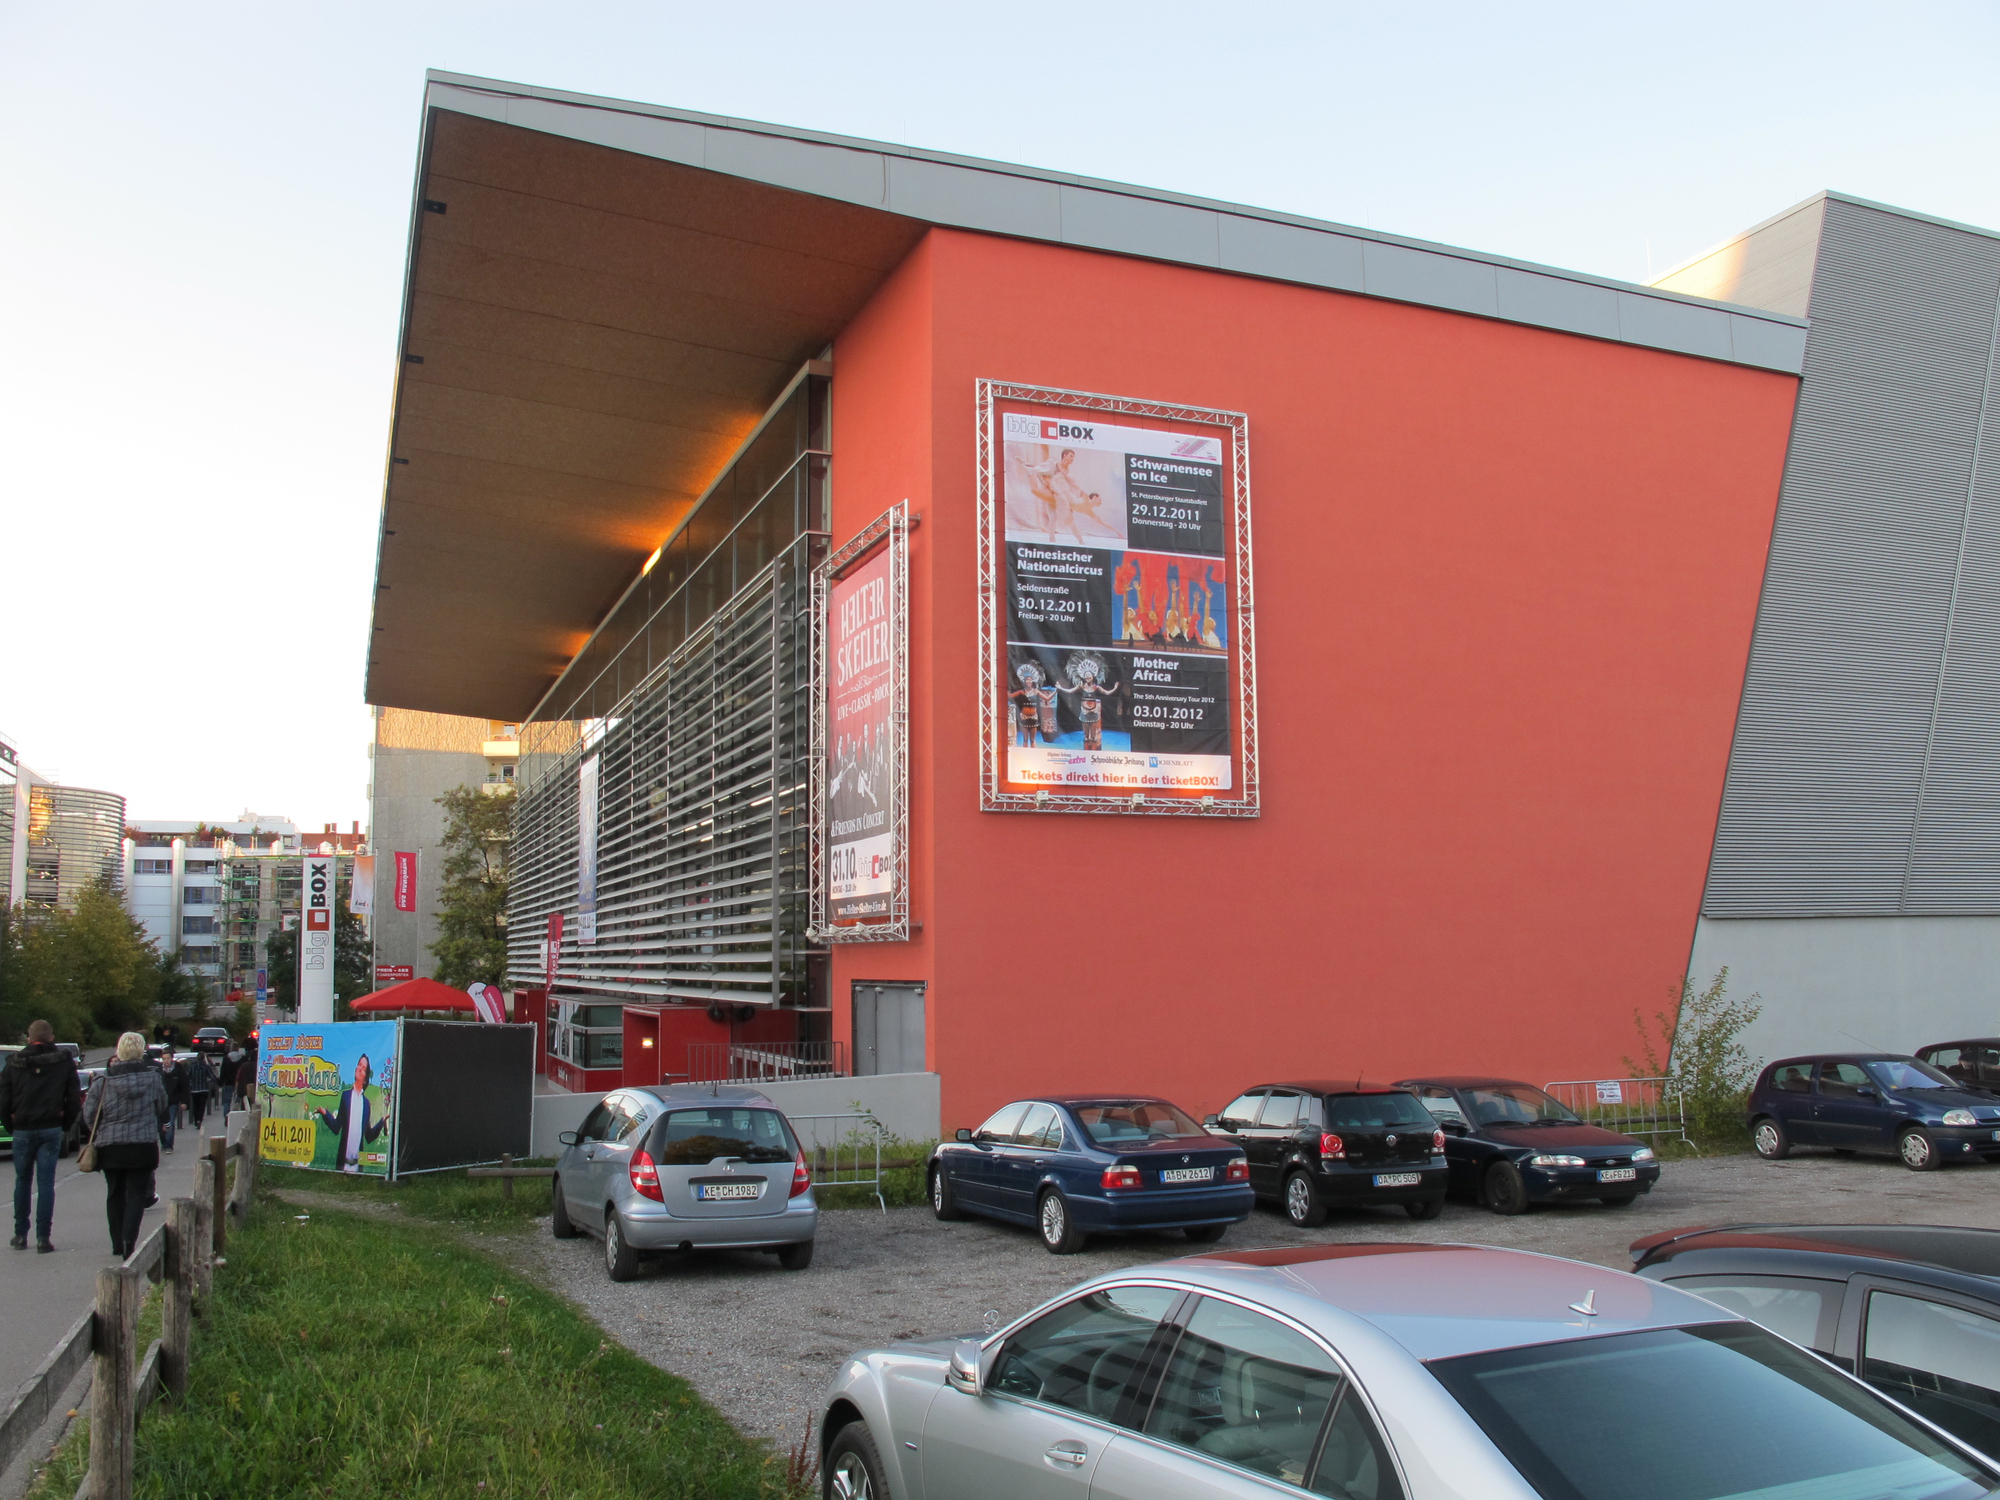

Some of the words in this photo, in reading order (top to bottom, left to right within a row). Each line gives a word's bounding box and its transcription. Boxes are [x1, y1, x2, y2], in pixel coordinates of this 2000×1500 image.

[1007, 416, 1040, 438] big
[1059, 424, 1094, 440] BOX
[1130, 457, 1213, 477] Schwanensee
[1130, 471, 1147, 481] on
[1150, 472, 1168, 483] Ice
[1139, 493, 1175, 503] Petersburger
[1132, 503, 1199, 521] 29.12.2011
[1132, 517, 1173, 529] Donnerstag
[1188, 523, 1202, 531] Uhr
[1017, 547, 1093, 563] Chinesischer
[1017, 559, 1103, 576] Nationalcircus
[1017, 583, 1069, 595] Seidenstraße
[1018, 597, 1090, 613] 30.12.2011
[1018, 611, 1044, 622] Freitag
[1049, 613, 1059, 621] 20
[1133, 656, 1179, 670] Mother
[1132, 669, 1171, 682] Africa
[1155, 694, 1187, 703] Anniversary
[1133, 705, 1203, 720] 03.01.2012
[1133, 720, 1165, 730] Dienstag
[1170, 721, 1180, 729] 20
[1021, 770, 1063, 781] Tickets
[1066, 772, 1099, 782] direkt
[1102, 773, 1124, 783] hier
[1128, 774, 1138, 784] in
[1141, 775, 1159, 785] der
[1162, 775, 1219, 786] ticketBOX!
[832, 847, 857, 882] 31.10.
[311, 863, 327, 907] BOX
[306, 932, 330, 970] big
[267, 1036, 294, 1050] DETLEV
[295, 1033, 323, 1050] JÖCKER
[264, 1121, 311, 1143] 04.11.2011
[1176, 1170, 1187, 1180] BW
[1189, 1168, 1209, 1179] 2612
[704, 1186, 716, 1197] KE
[722, 1186, 734, 1196] CH
[735, 1185, 757, 1196] 1982
